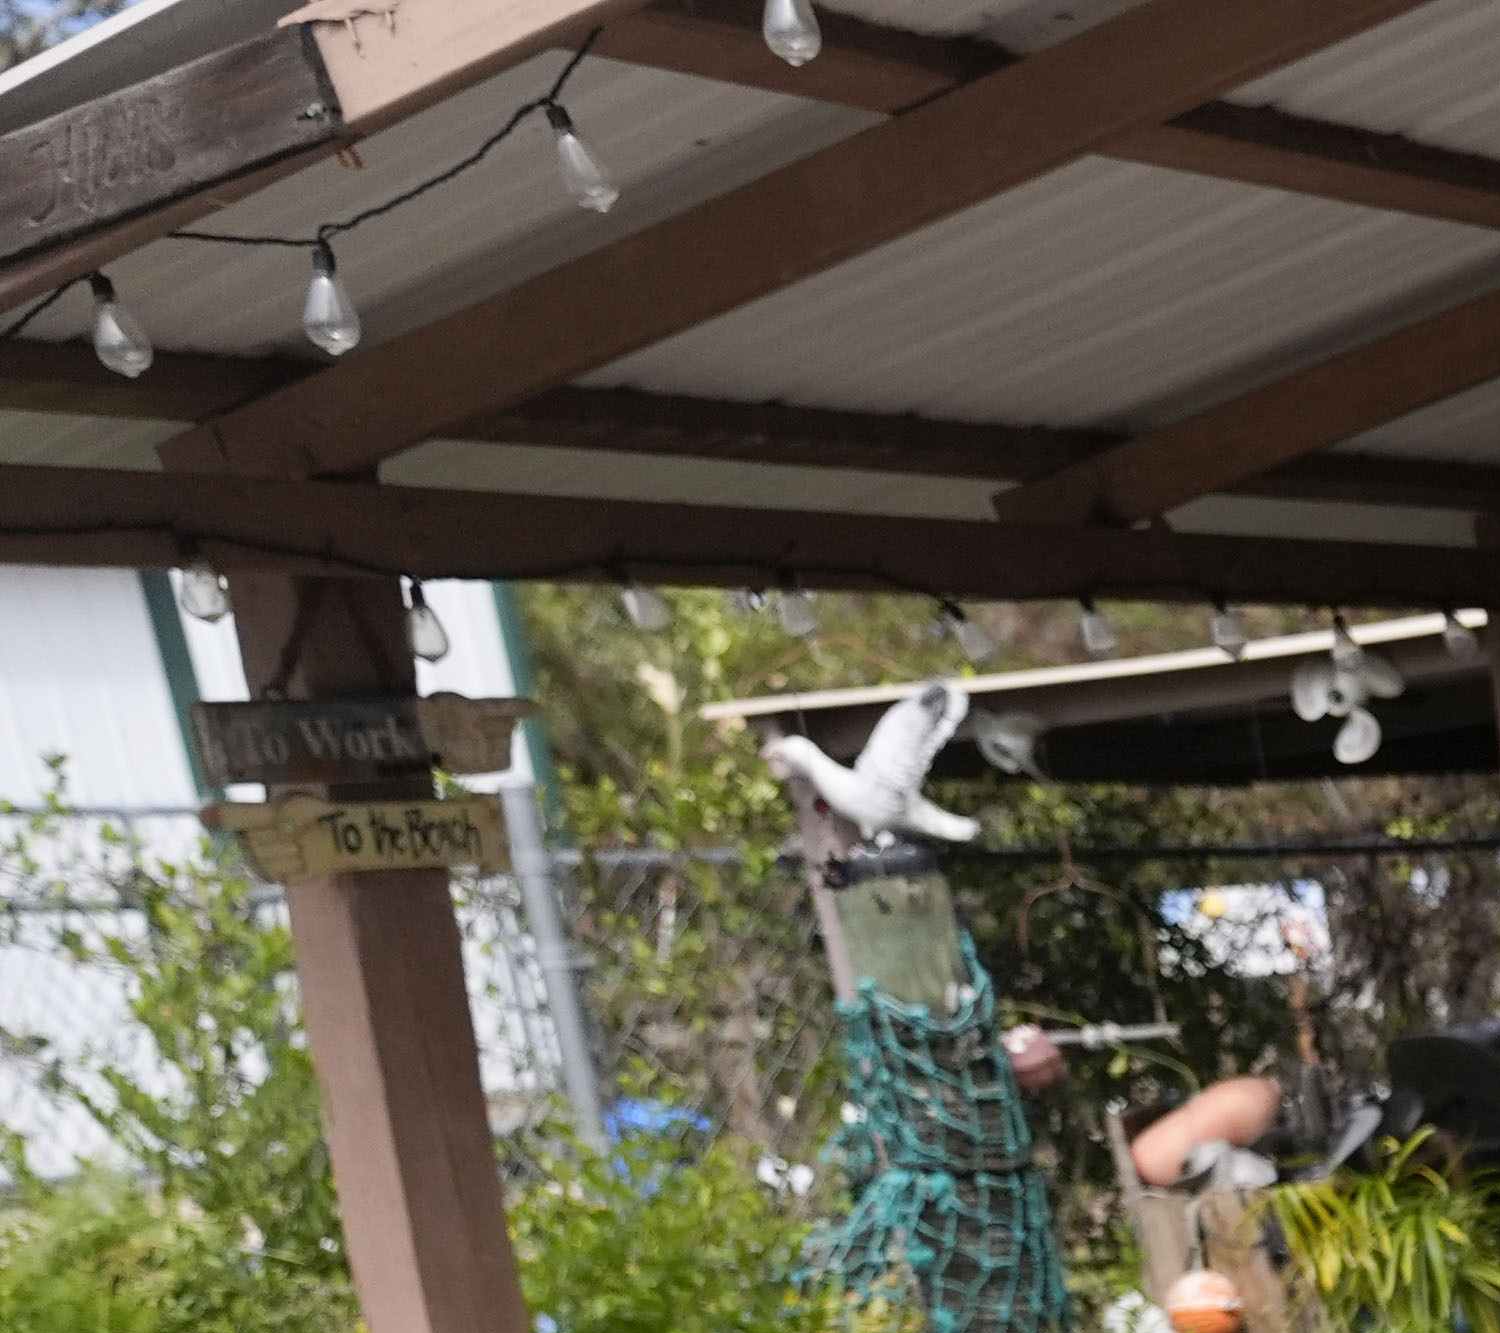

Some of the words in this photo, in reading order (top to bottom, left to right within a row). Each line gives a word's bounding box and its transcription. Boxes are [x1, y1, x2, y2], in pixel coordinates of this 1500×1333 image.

[240, 723, 290, 763] To
[297, 714, 420, 761] Work
[317, 809, 364, 856] To
[406, 807, 482, 859] Beach
